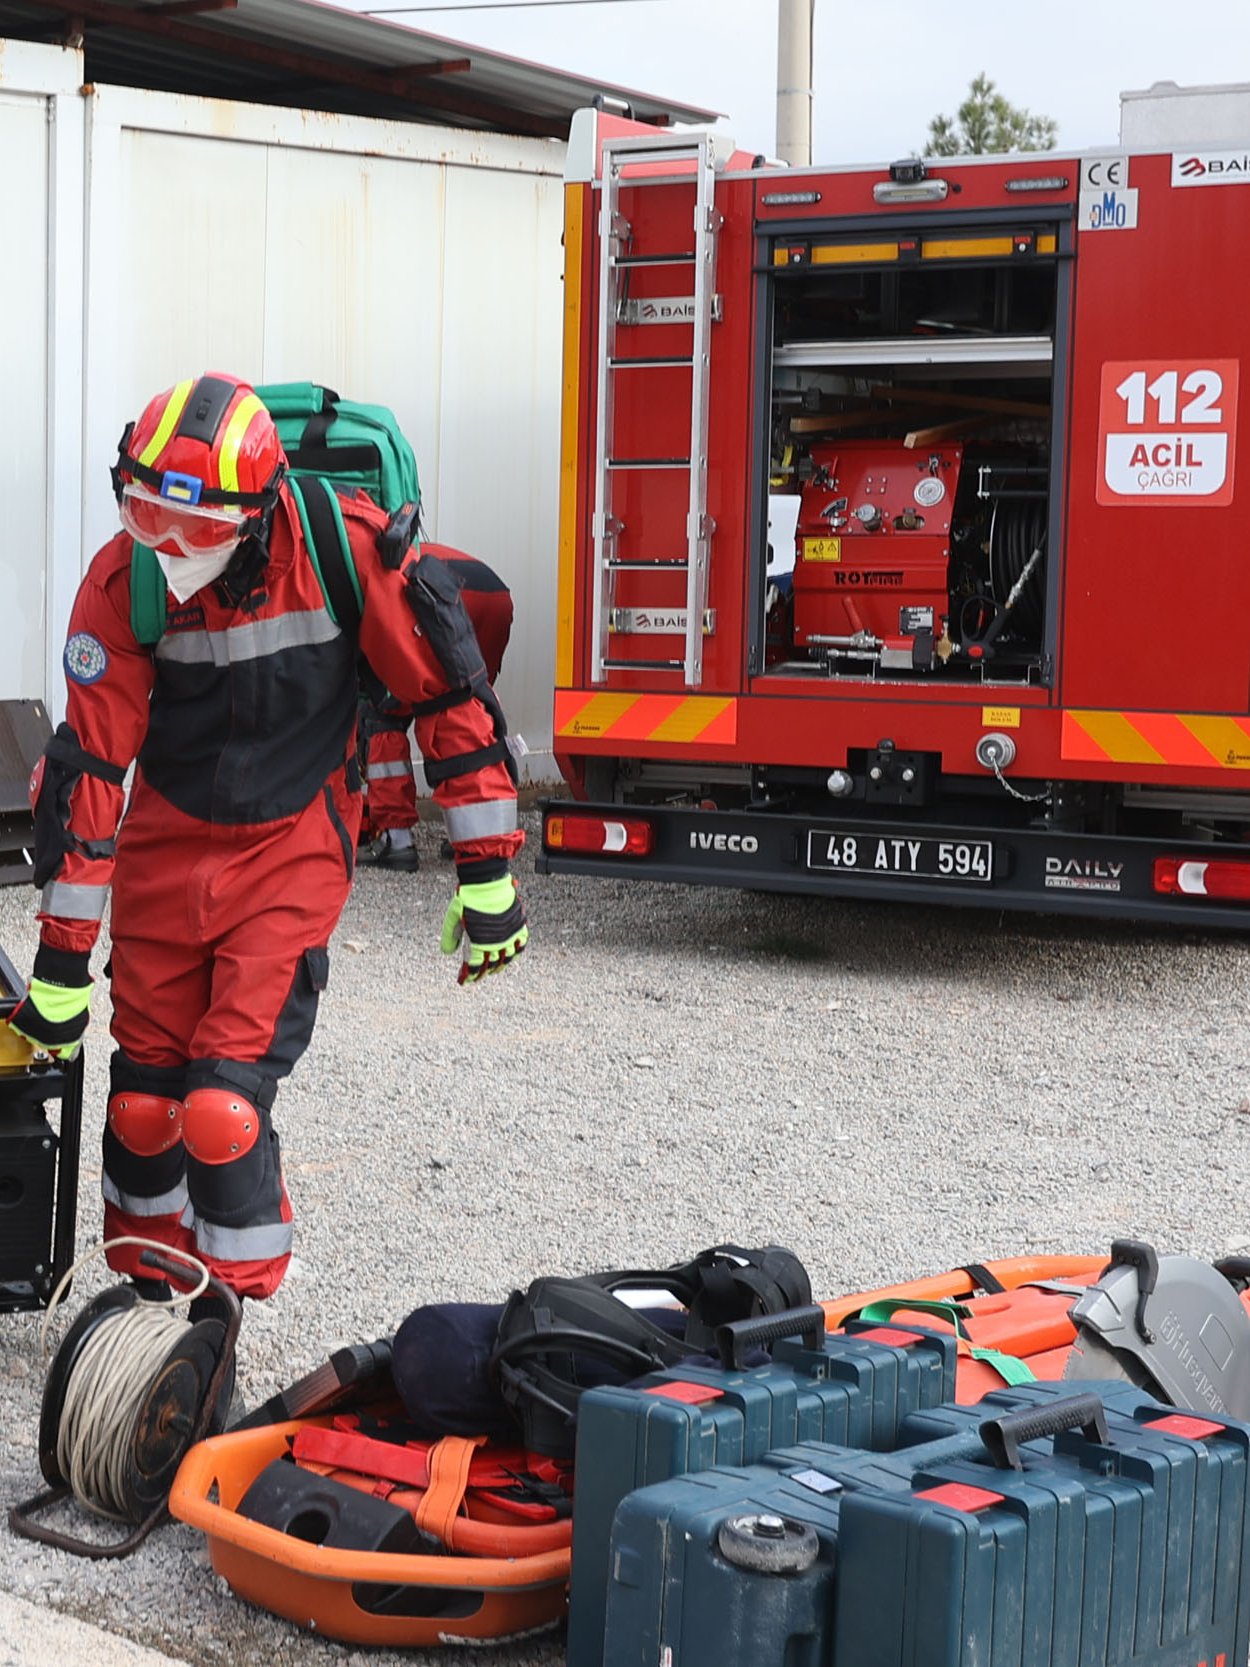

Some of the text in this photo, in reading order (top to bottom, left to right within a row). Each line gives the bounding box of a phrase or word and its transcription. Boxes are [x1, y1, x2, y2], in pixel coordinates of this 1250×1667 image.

[1090, 191, 1127, 230] DMO
[1115, 369, 1223, 425] 112
[1128, 437, 1203, 468] ACİL
[1137, 469, 1193, 491] ÇAĞRI
[690, 832, 759, 853] IVECO
[826, 836, 986, 877] 48 ATY 594
[1046, 856, 1124, 878] DAILY
